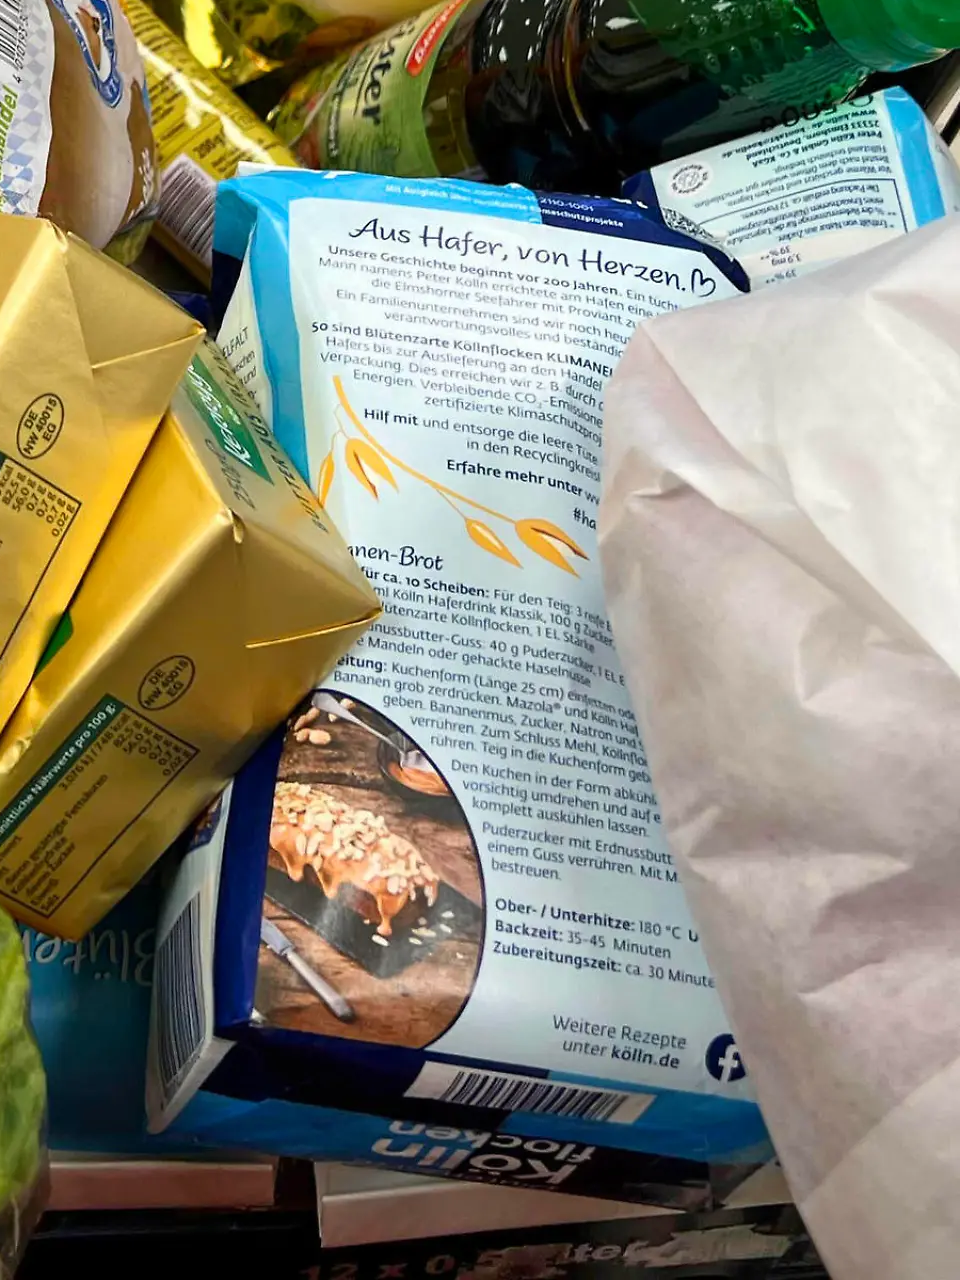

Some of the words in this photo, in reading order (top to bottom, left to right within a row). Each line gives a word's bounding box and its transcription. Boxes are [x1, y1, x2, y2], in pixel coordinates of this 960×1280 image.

[328, 244, 378, 261] Unsere
[379, 251, 457, 272] Geschichte
[459, 263, 513, 281] beginnt
[516, 272, 539, 284] vor
[571, 279, 624, 297] Jahren.
[348, 218, 412, 242] Aus
[417, 223, 511, 262] Hafer,
[515, 245, 571, 267] von
[576, 247, 690, 291] Herzen.
[318, 257, 357, 271] Mann
[359, 263, 413, 279] namens
[416, 269, 451, 284] Peter
[492, 281, 557, 299] errichtete
[331, 323, 361, 336] sind
[364, 327, 450, 348] Blütenzarte
[452, 339, 544, 361] Köllnflocken
[319, 351, 404, 371] Verpackung.
[408, 362, 437, 375] Dies
[441, 368, 506, 384] erreichen
[420, 349, 507, 372] Auslieferung
[420, 379, 510, 400] Verbleibende
[22, 409, 38, 429] DE
[41, 421, 57, 441] EG
[363, 408, 390, 424] Hilf
[393, 413, 418, 425] mit
[452, 420, 515, 441] entsorge
[517, 431, 540, 443] die
[445, 459, 502, 477] Erfahre
[504, 469, 545, 484] mehr
[546, 477, 583, 497] unter
[422, 578, 490, 597] Scheiben:
[427, 594, 497, 614] Haferdrink
[366, 637, 425, 656] Mandeln
[427, 647, 458, 660] oder
[461, 651, 522, 669] gehackte
[332, 671, 391, 688] Bananen
[393, 681, 424, 693] grob
[391, 663, 471, 685] Kuchenform
[73, 728, 93, 749] pro
[86, 709, 108, 731] 100
[480, 724, 511, 739] Zum
[512, 729, 561, 747] Schluss
[450, 759, 479, 774] Den
[481, 763, 532, 783] Kuchen
[575, 779, 612, 796] Form
[548, 753, 627, 778] Kuchenform
[461, 778, 529, 801] vorsichtig
[530, 790, 600, 812] umdrehen
[471, 798, 533, 817] komplett
[536, 809, 604, 829] auskühlen
[481, 821, 565, 846] Puderzucker
[567, 836, 592, 850] mit
[486, 841, 529, 857] einem
[532, 846, 565, 863] Guss
[490, 858, 563, 881] bestreuen.
[494, 898, 537, 915] Ober-
[549, 906, 637, 931] Unterhitze:
[639, 920, 661, 936] 180
[494, 919, 564, 942] Backzeit:
[612, 938, 671, 959] Minuten
[492, 940, 622, 975] Zubereitungszeit:
[551, 1014, 617, 1038] Weitere
[620, 1025, 687, 1050] Rezepte
[562, 1038, 607, 1056] unter
[610, 1044, 681, 1069] kölln.de
[387, 1119, 595, 1164] flocken
[370, 1136, 577, 1186] Kölln
